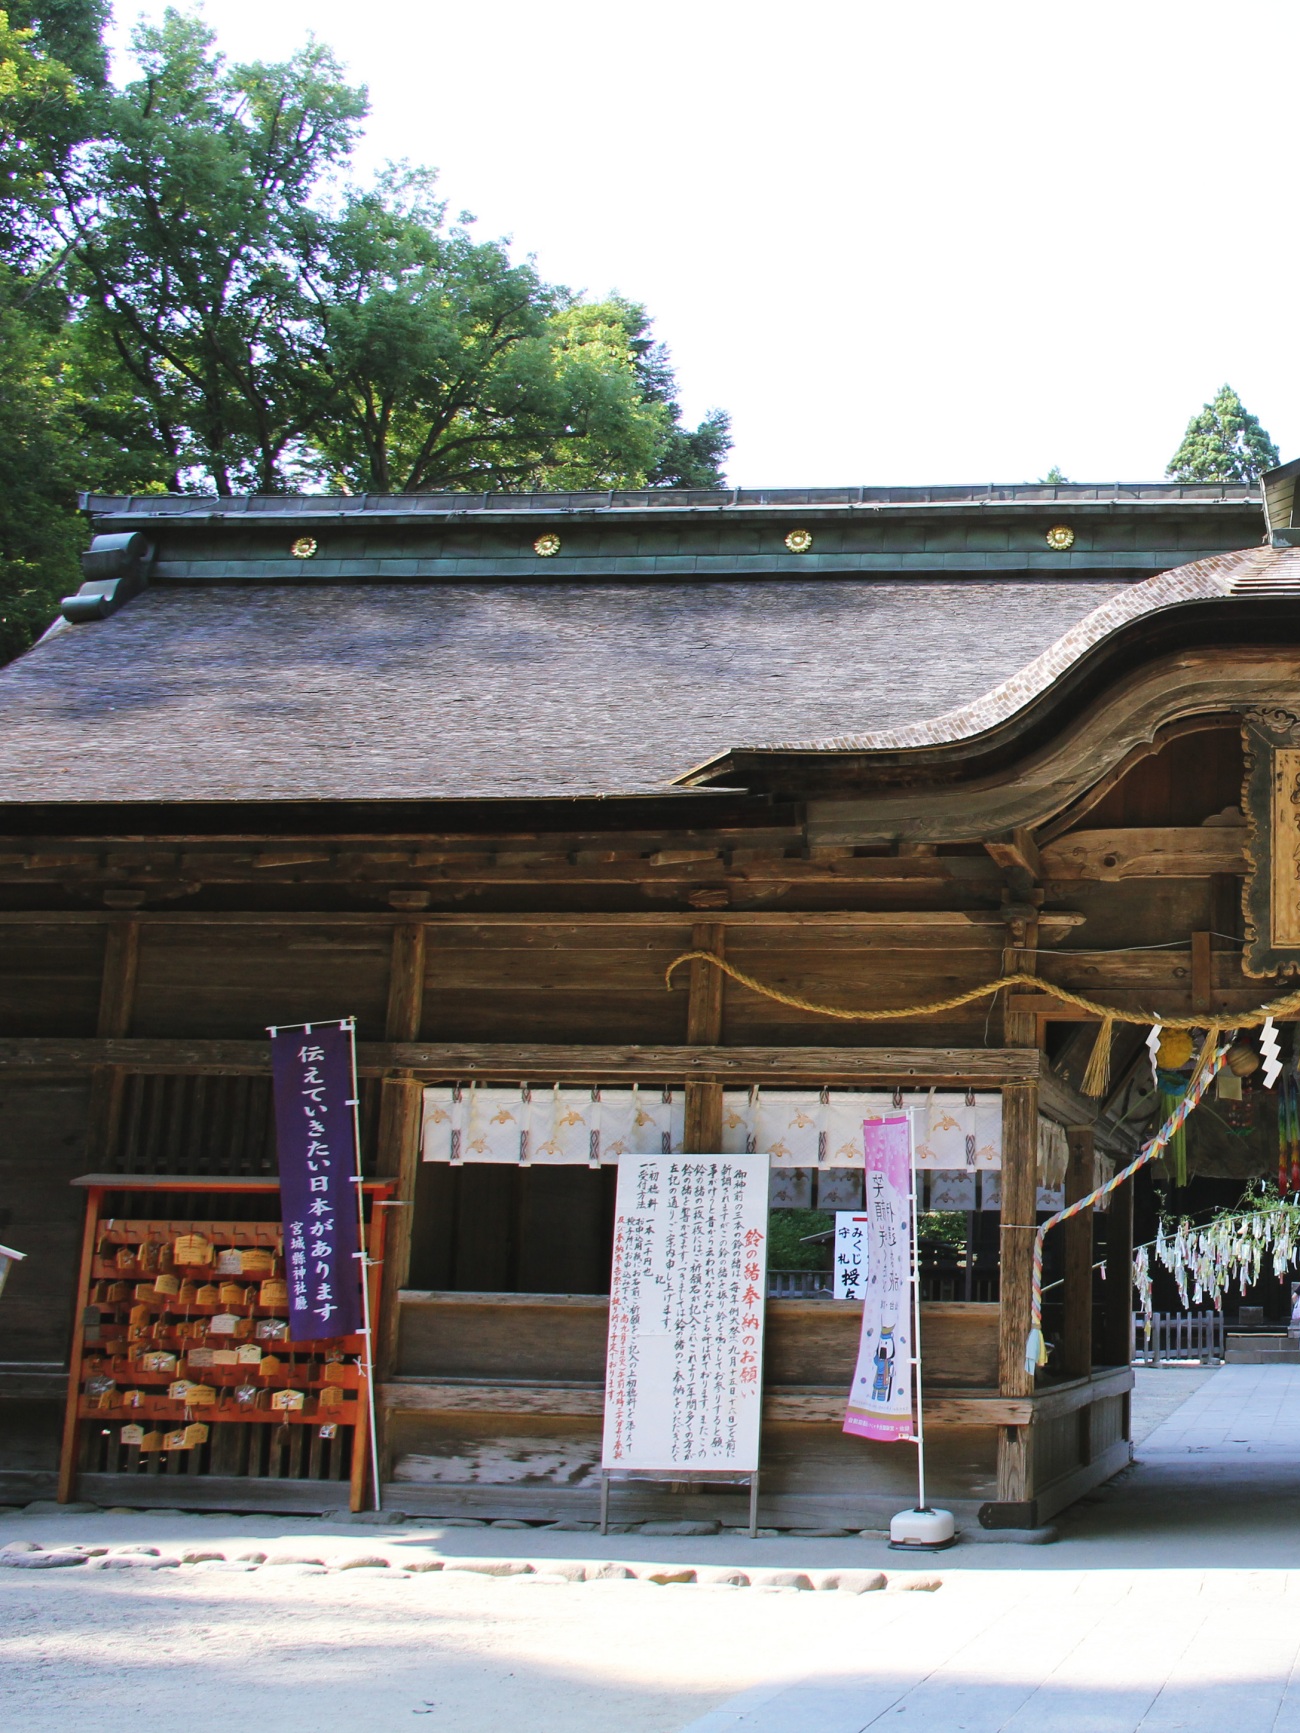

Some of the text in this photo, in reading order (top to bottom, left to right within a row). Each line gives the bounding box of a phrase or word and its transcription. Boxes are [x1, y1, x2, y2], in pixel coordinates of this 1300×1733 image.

[297, 1046, 338, 1322] 伝えていきたい日本があります
[655, 1274, 666, 1285] 記
[739, 1228, 764, 1399] 鈴の緒奉納のお願い
